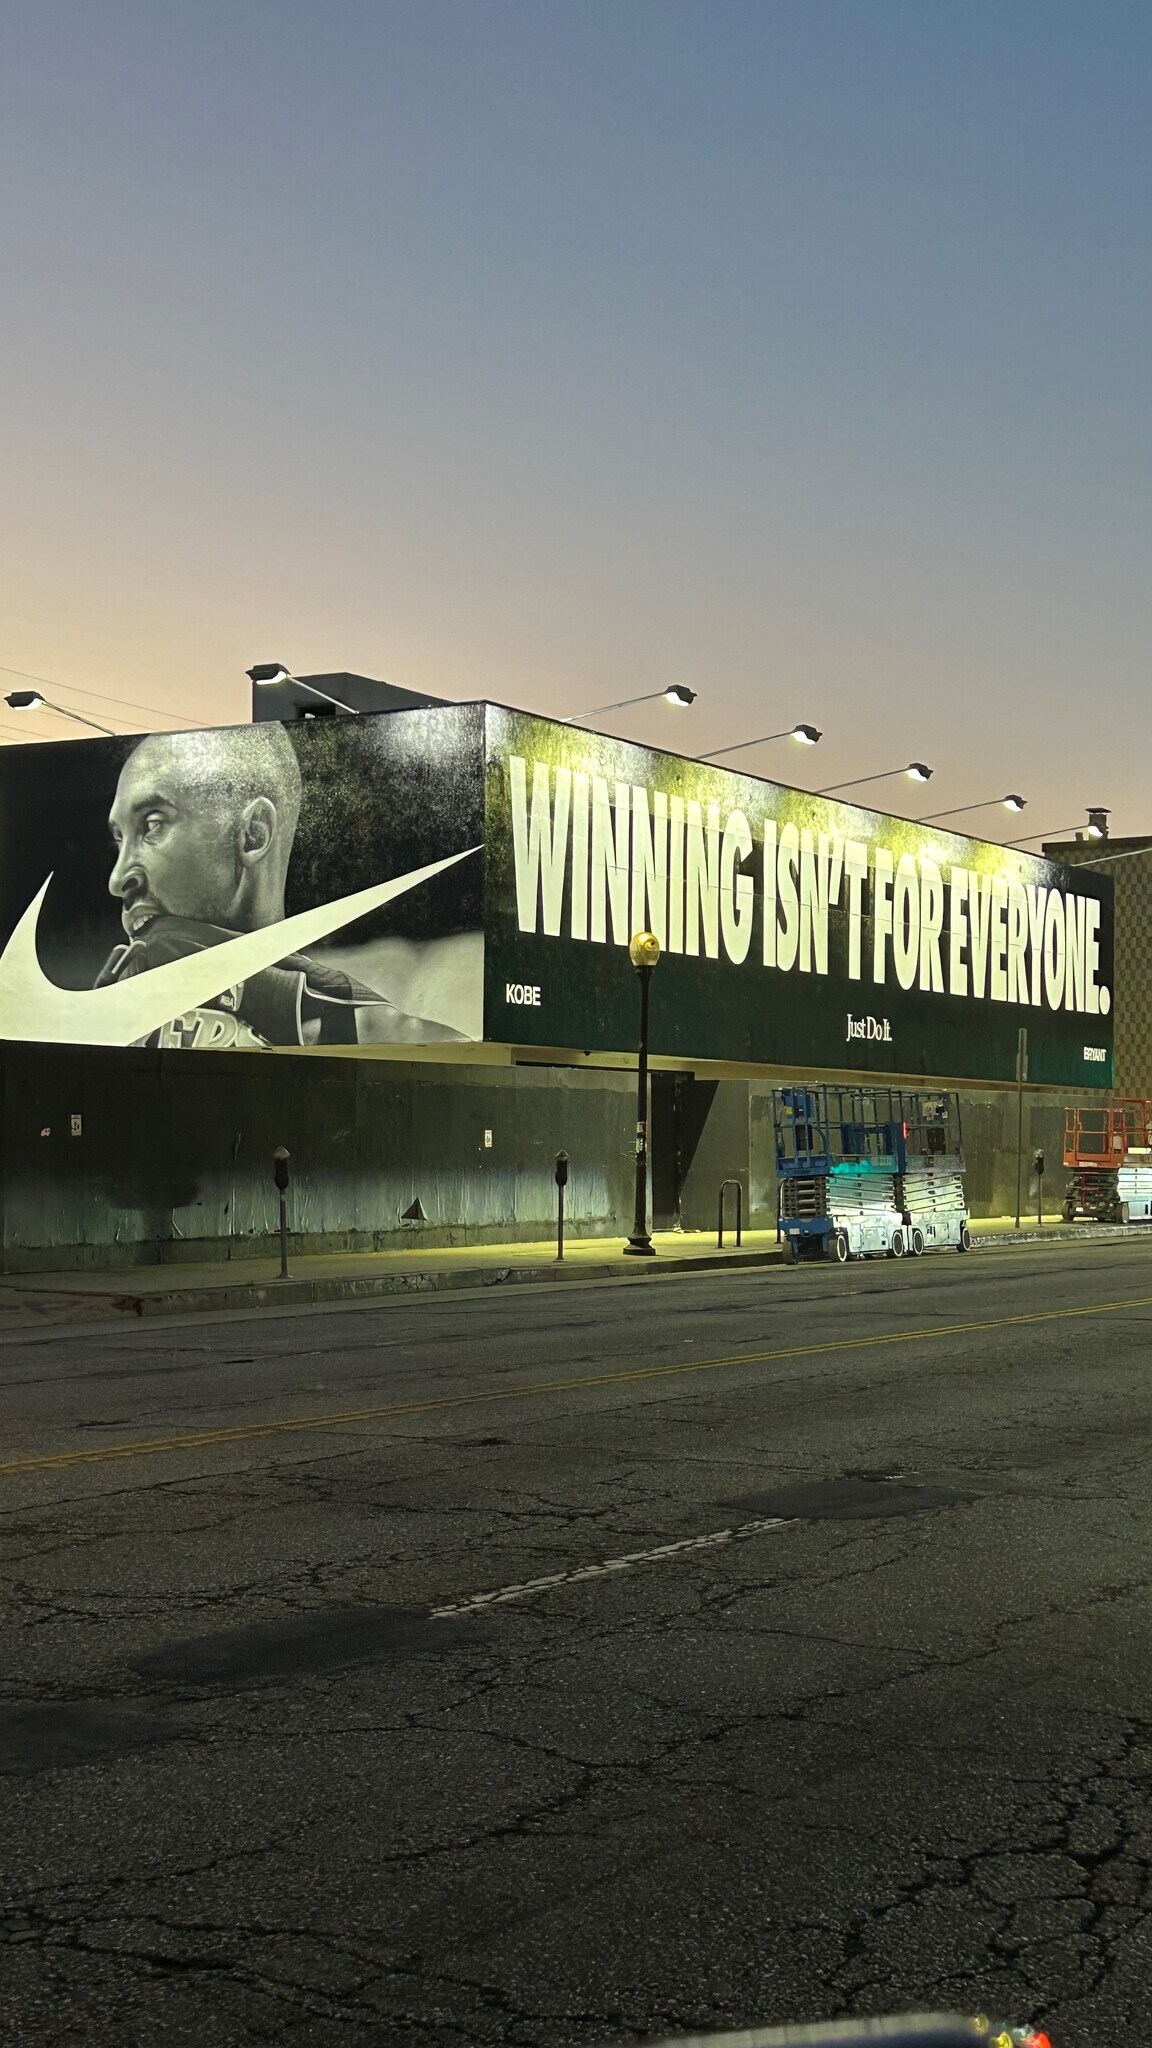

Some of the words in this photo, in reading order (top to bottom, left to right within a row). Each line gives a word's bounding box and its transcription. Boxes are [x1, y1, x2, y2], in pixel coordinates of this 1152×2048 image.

[509, 755, 754, 965] WINNING
[763, 818, 868, 980] ISN'T
[873, 847, 945, 994] FOR
[950, 865, 1111, 1015] EVERYONE.
[506, 983, 542, 1006] KOBE
[846, 1013, 866, 1042] Just
[866, 1016, 883, 1040] Do
[1083, 1046, 1107, 1062] BRYANT
